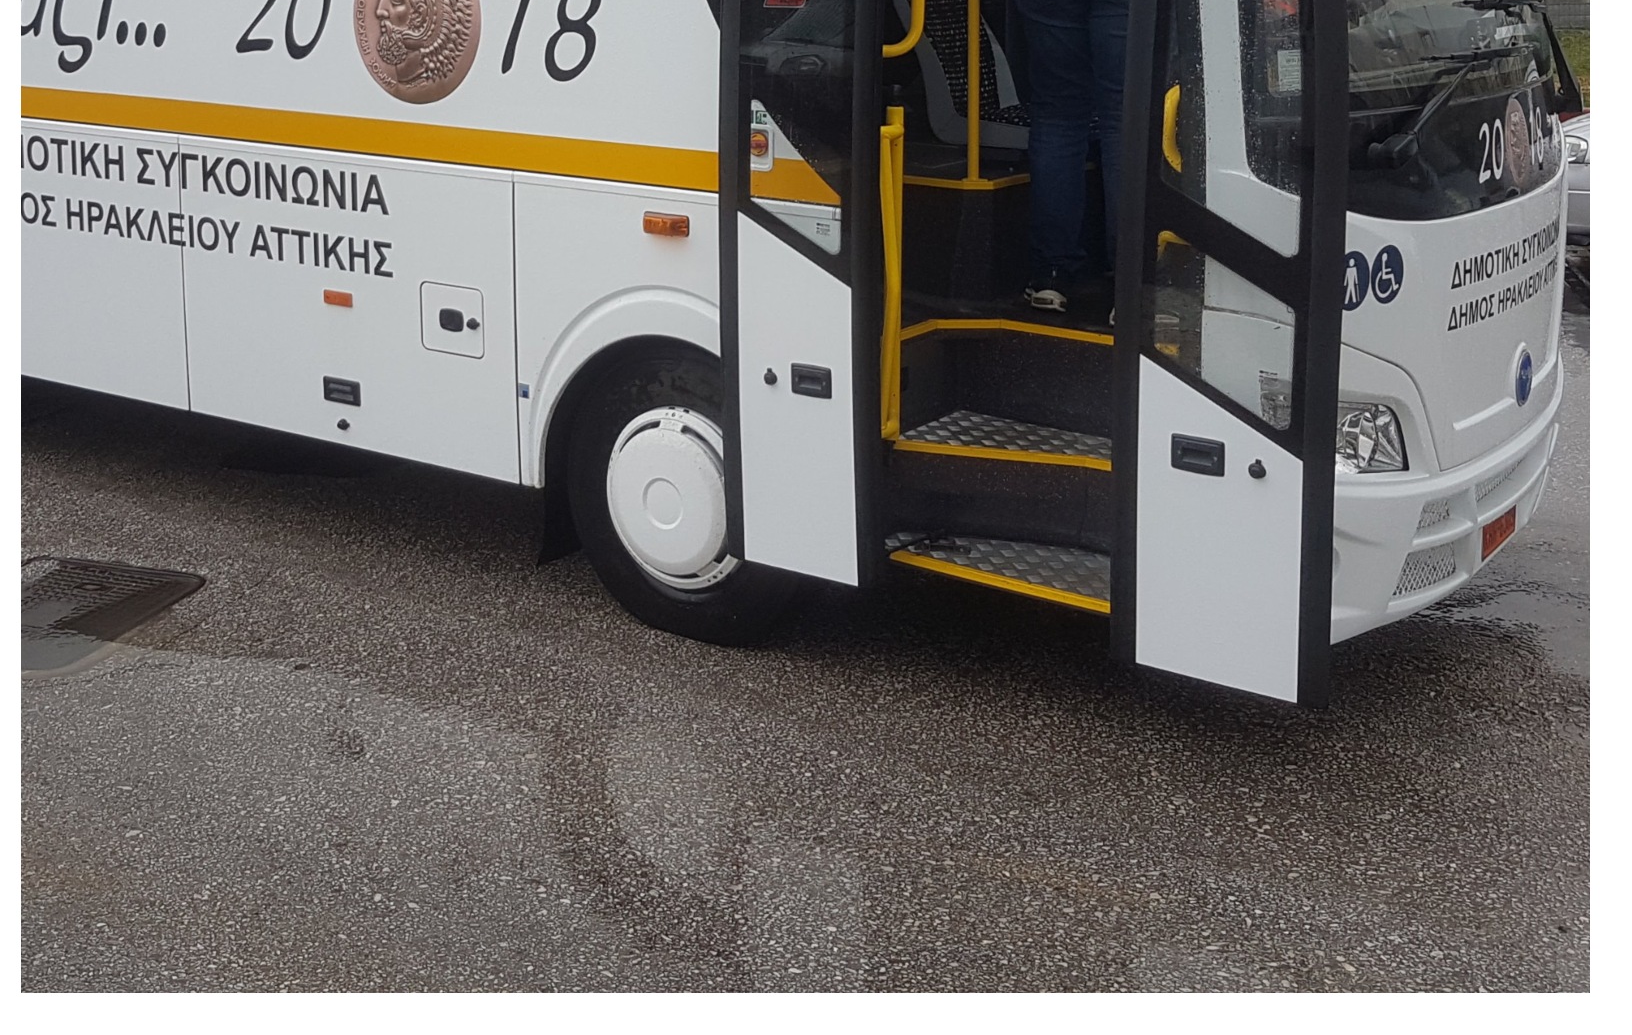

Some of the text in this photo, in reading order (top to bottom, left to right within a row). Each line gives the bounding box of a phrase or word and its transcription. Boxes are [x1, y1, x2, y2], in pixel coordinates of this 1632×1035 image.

[21, 134, 390, 216] ΟΤΙΚΗ ΣΥΓΚΟΙΝΩΝΙΑ
[1478, 118, 1504, 184] 20
[66, 197, 240, 255] ΗΡΑΚΛΕΙΟΥ
[249, 224, 394, 278] ΑΤΤΙΚΗΣ
[1450, 241, 1520, 290] ΔΗΜΟΤΙΚΗ
[1447, 293, 1495, 332] ΔΗΜΟΣ
